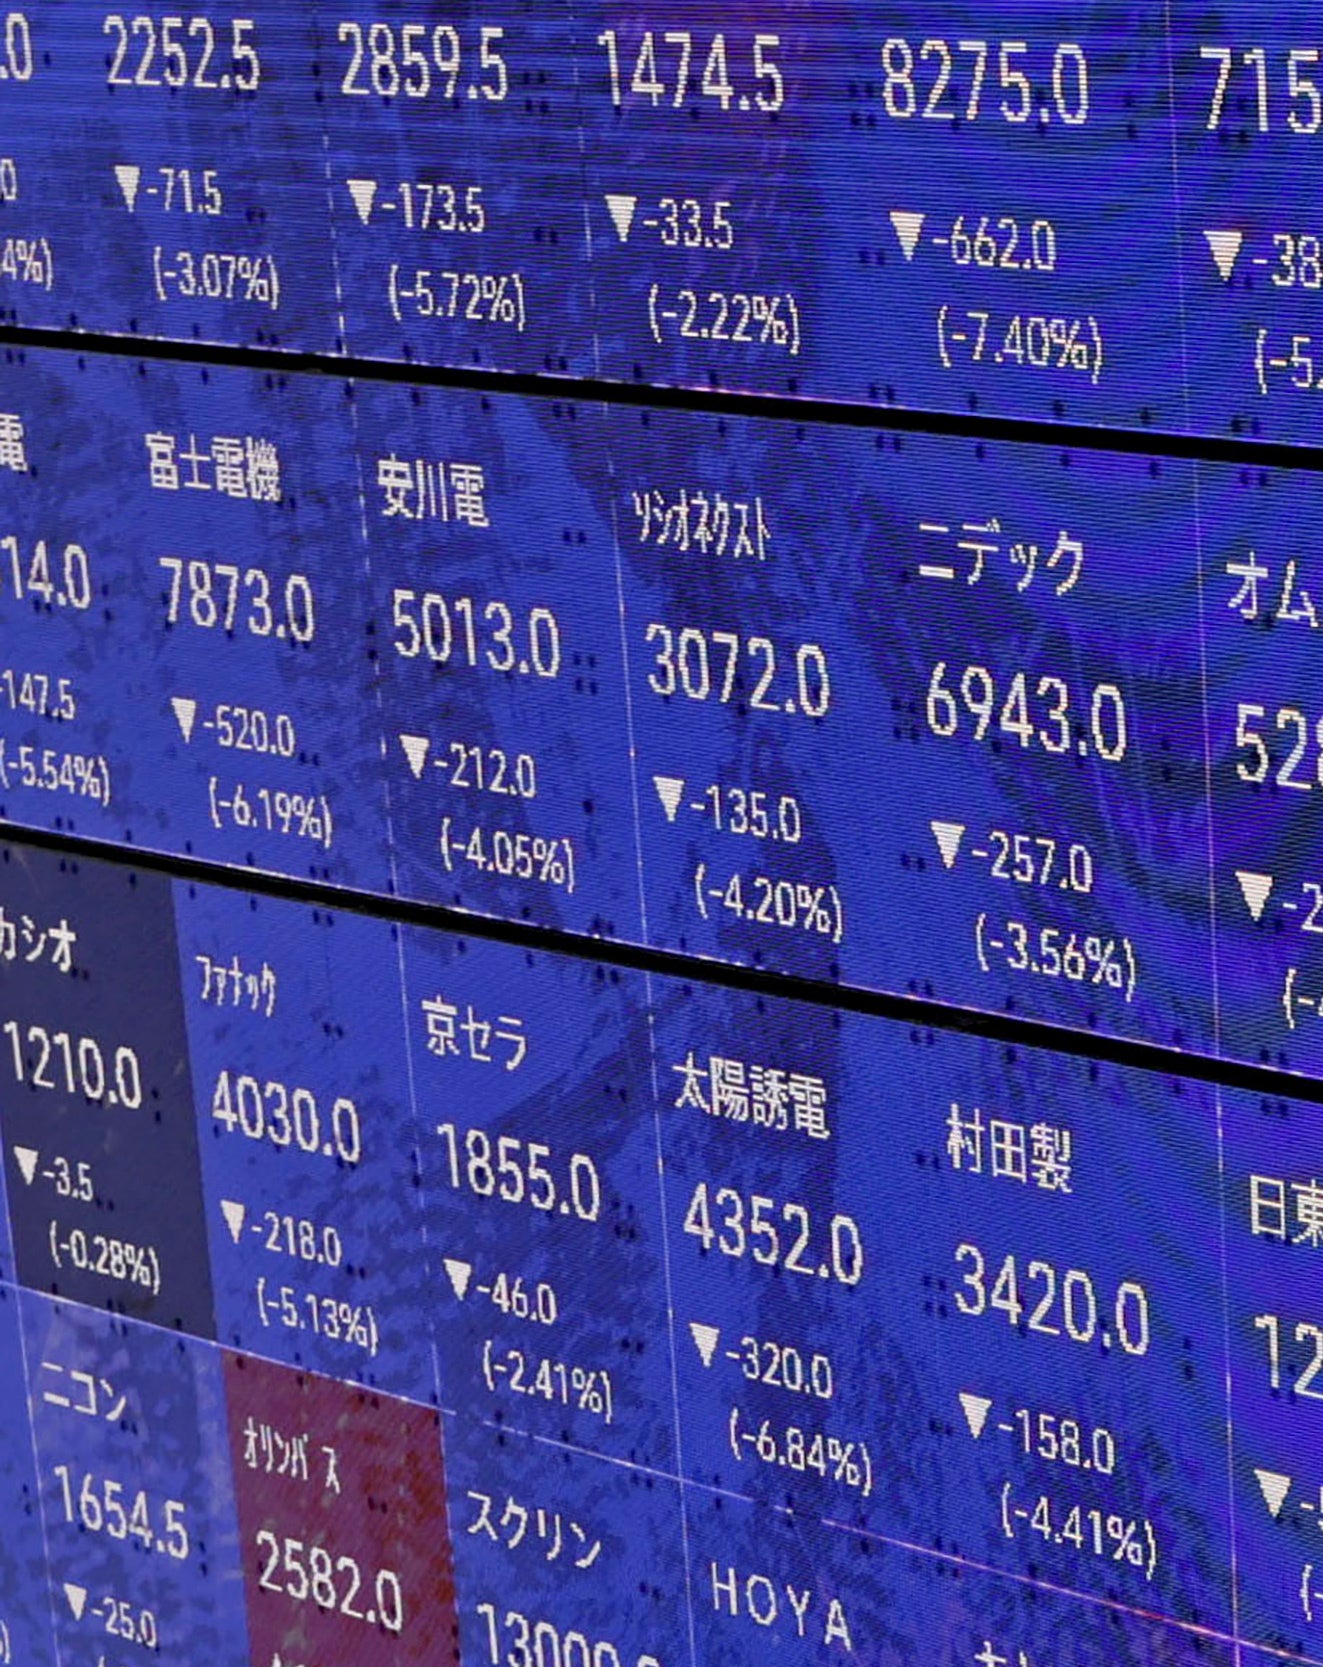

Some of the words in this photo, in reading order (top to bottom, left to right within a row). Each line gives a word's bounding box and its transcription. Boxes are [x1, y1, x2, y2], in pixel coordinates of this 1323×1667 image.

[103, 14, 260, 90] 2252.5
[337, 21, 508, 102] 2859.5
[597, 29, 784, 112] 1474.5
[881, 37, 1089, 125] 8275.0
[933, 216, 1056, 272] -662.0
[388, 264, 525, 331] (-5.72%)
[144, 432, 280, 501] 富士電機
[377, 453, 490, 528] 安川電
[918, 518, 1084, 596] ニデック
[159, 557, 315, 641] 7873.0
[645, 623, 831, 717] 3072.0
[926, 662, 1127, 762] 6943.0
[435, 742, 536, 799] -212.0
[975, 914, 1137, 1002] (-3.56%)
[3, 1021, 142, 1109] 1210.0
[421, 997, 526, 1071] 京セラ
[212, 1071, 360, 1162] 4030.0
[672, 1053, 830, 1139] 太陽誘電
[43, 1156, 93, 1202] -3.5
[436, 1123, 601, 1221] 1855.0
[946, 1103, 1071, 1193] 村田製
[683, 1182, 863, 1285] 4352.0
[42, 1361, 126, 1421] ニコン
[482, 1340, 613, 1422] (-2.41%)
[998, 1409, 1116, 1474] -158.0
[54, 1465, 189, 1560] 1654.5
[468, 1491, 601, 1568] スクリン
